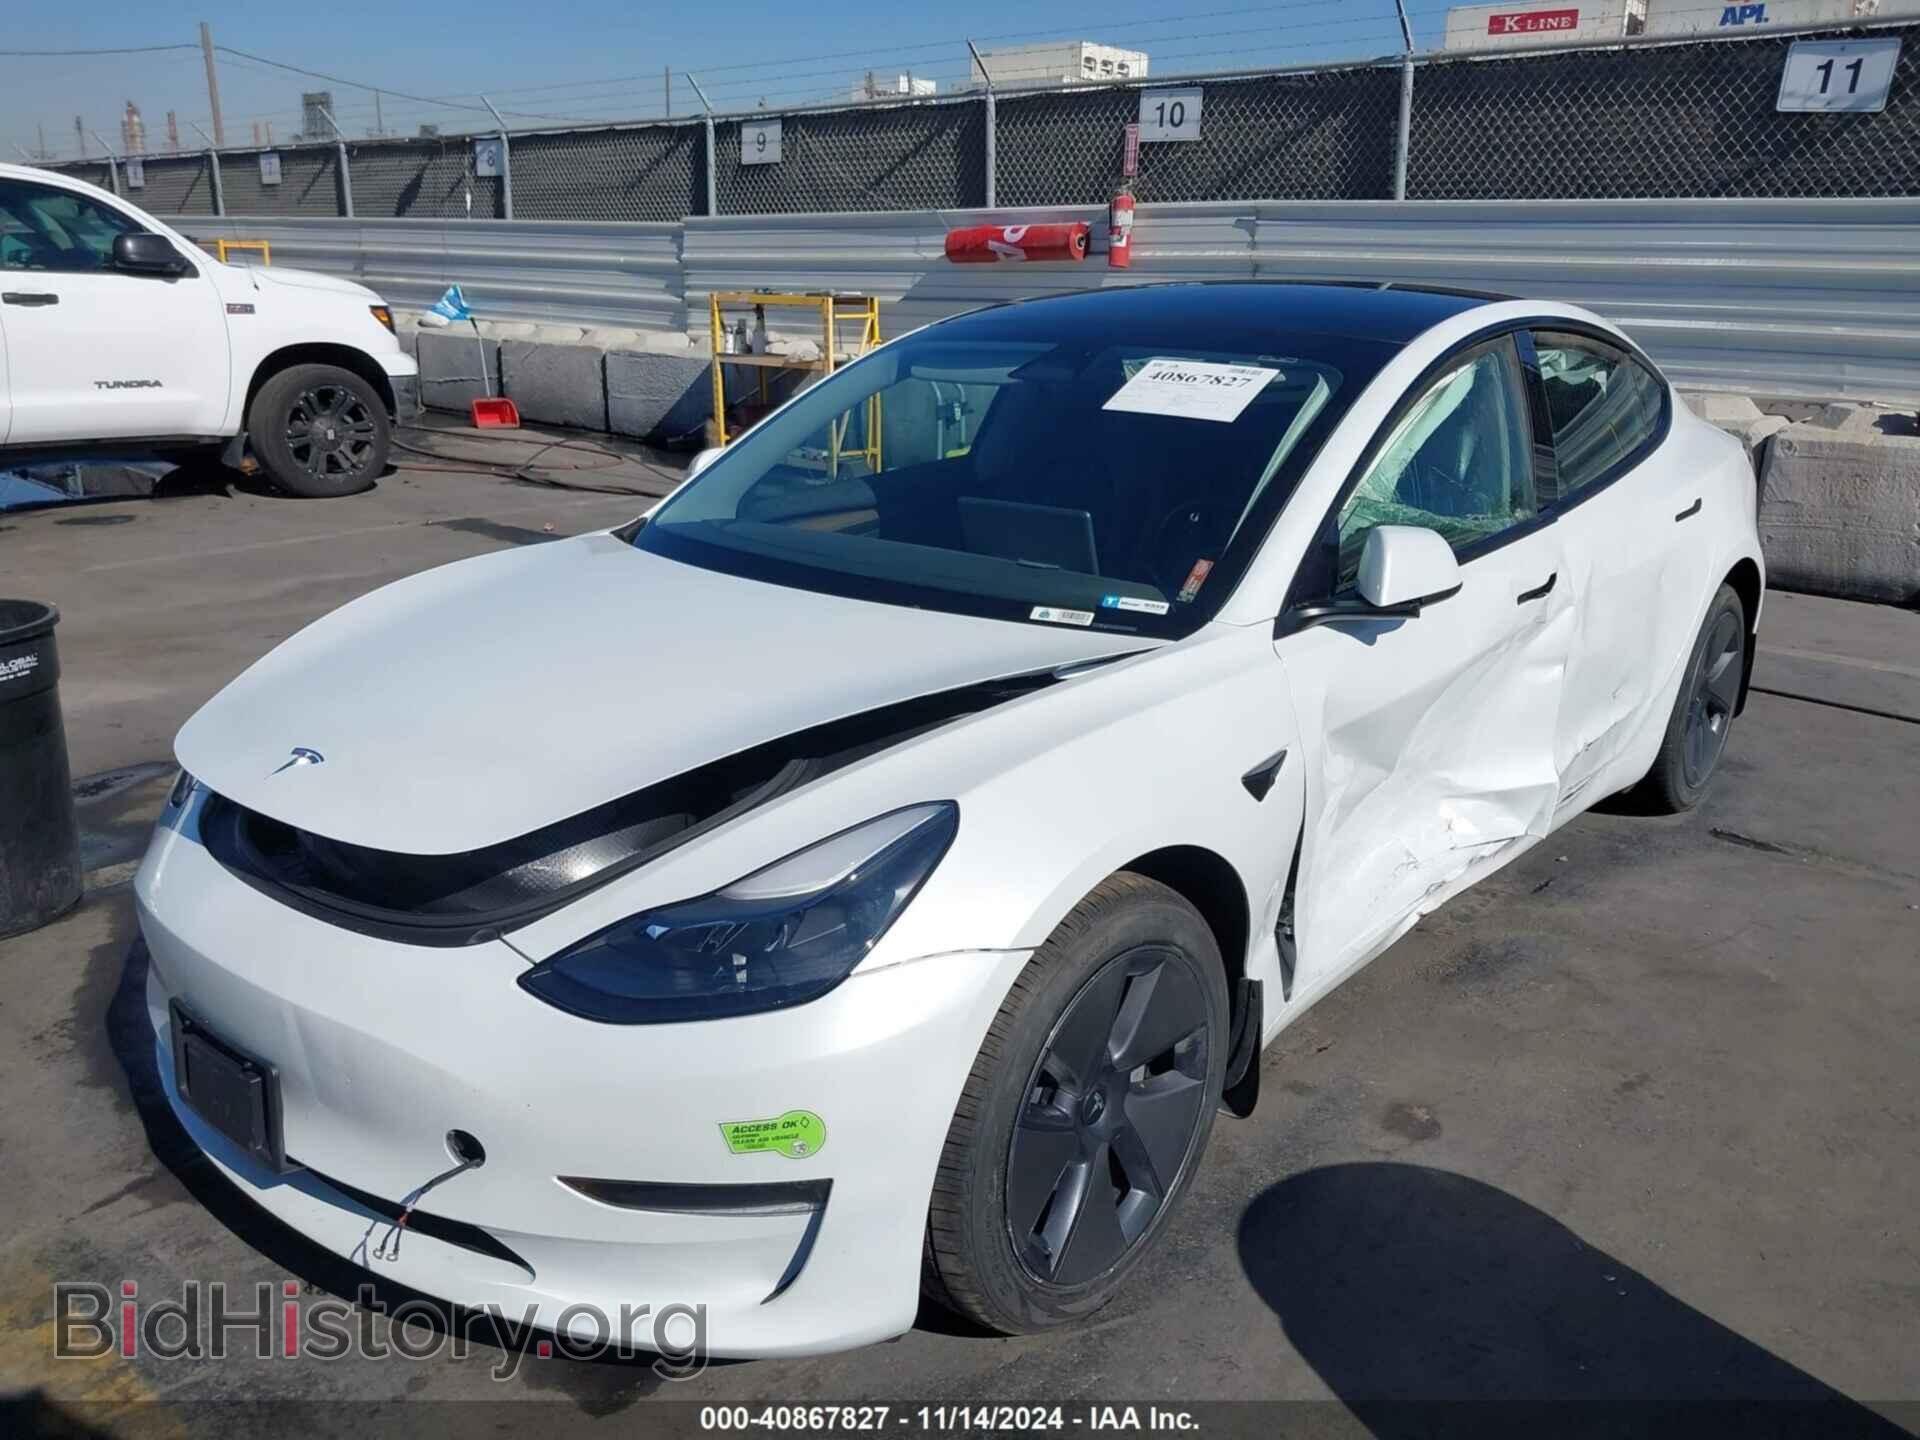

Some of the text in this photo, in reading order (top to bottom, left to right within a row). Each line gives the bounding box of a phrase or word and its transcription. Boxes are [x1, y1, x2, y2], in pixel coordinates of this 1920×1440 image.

[1503, 15, 1572, 32] K LINE
[1816, 58, 1864, 94] 11
[1155, 101, 1185, 128] 10
[757, 132, 766, 152] 9
[94, 379, 163, 390] TUNDRA
[1148, 370, 1253, 388] 40867827
[731, 1119, 799, 1134] ACCESS OK
